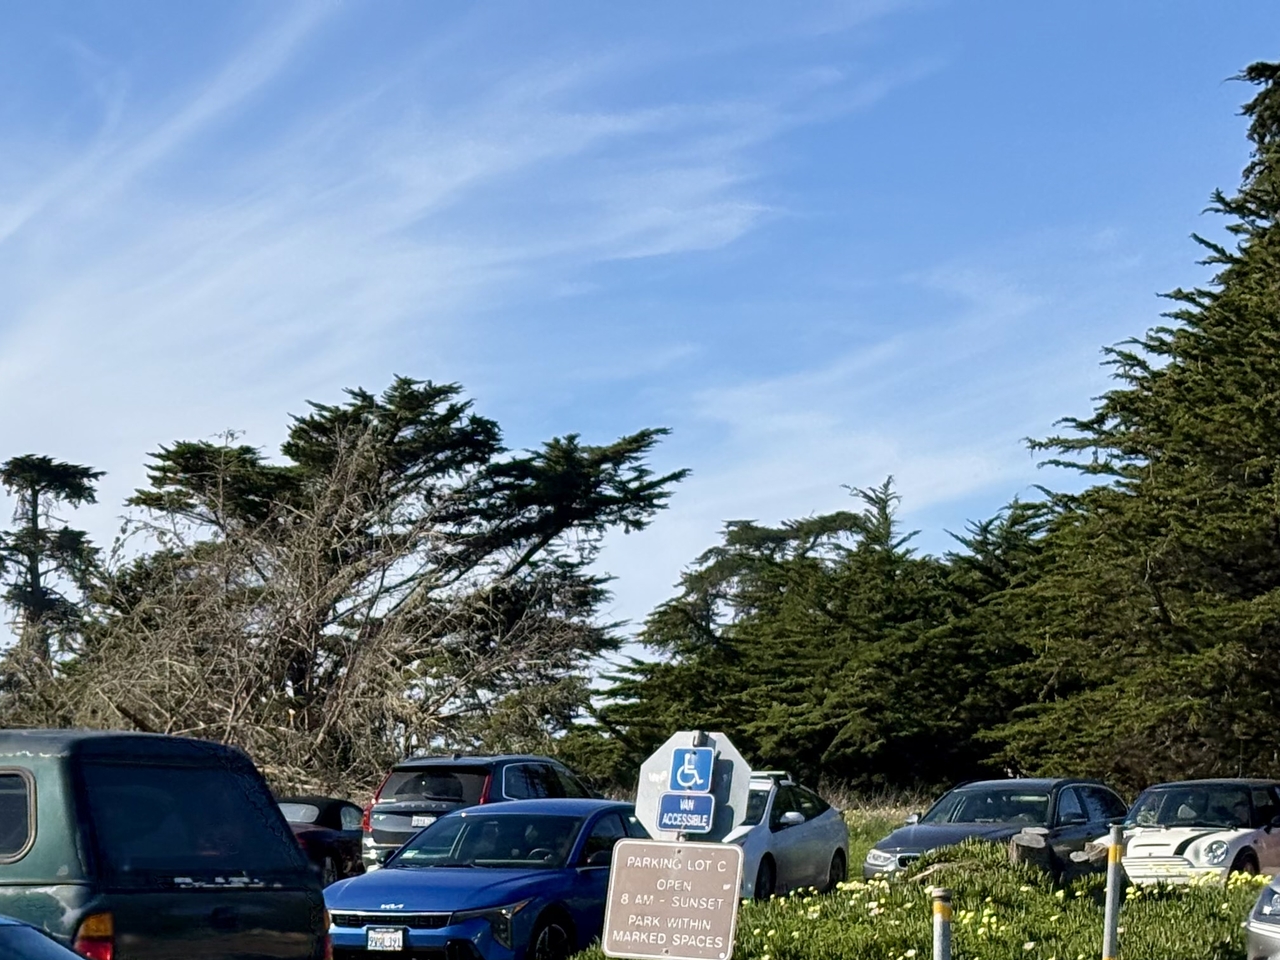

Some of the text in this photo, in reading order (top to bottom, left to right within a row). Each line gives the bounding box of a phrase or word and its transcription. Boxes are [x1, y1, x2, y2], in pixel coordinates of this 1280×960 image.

[679, 798, 694, 811] VAN
[662, 811, 708, 827] ACCESSIBLE
[627, 856, 727, 873] PARKING LOT C
[656, 878, 692, 892] OPEN
[620, 892, 629, 905] 8
[634, 894, 654, 906] AM
[671, 895, 725, 910] SUNSET
[628, 914, 711, 931] PARK WITHIN
[612, 930, 724, 949] MARKED SPACES
